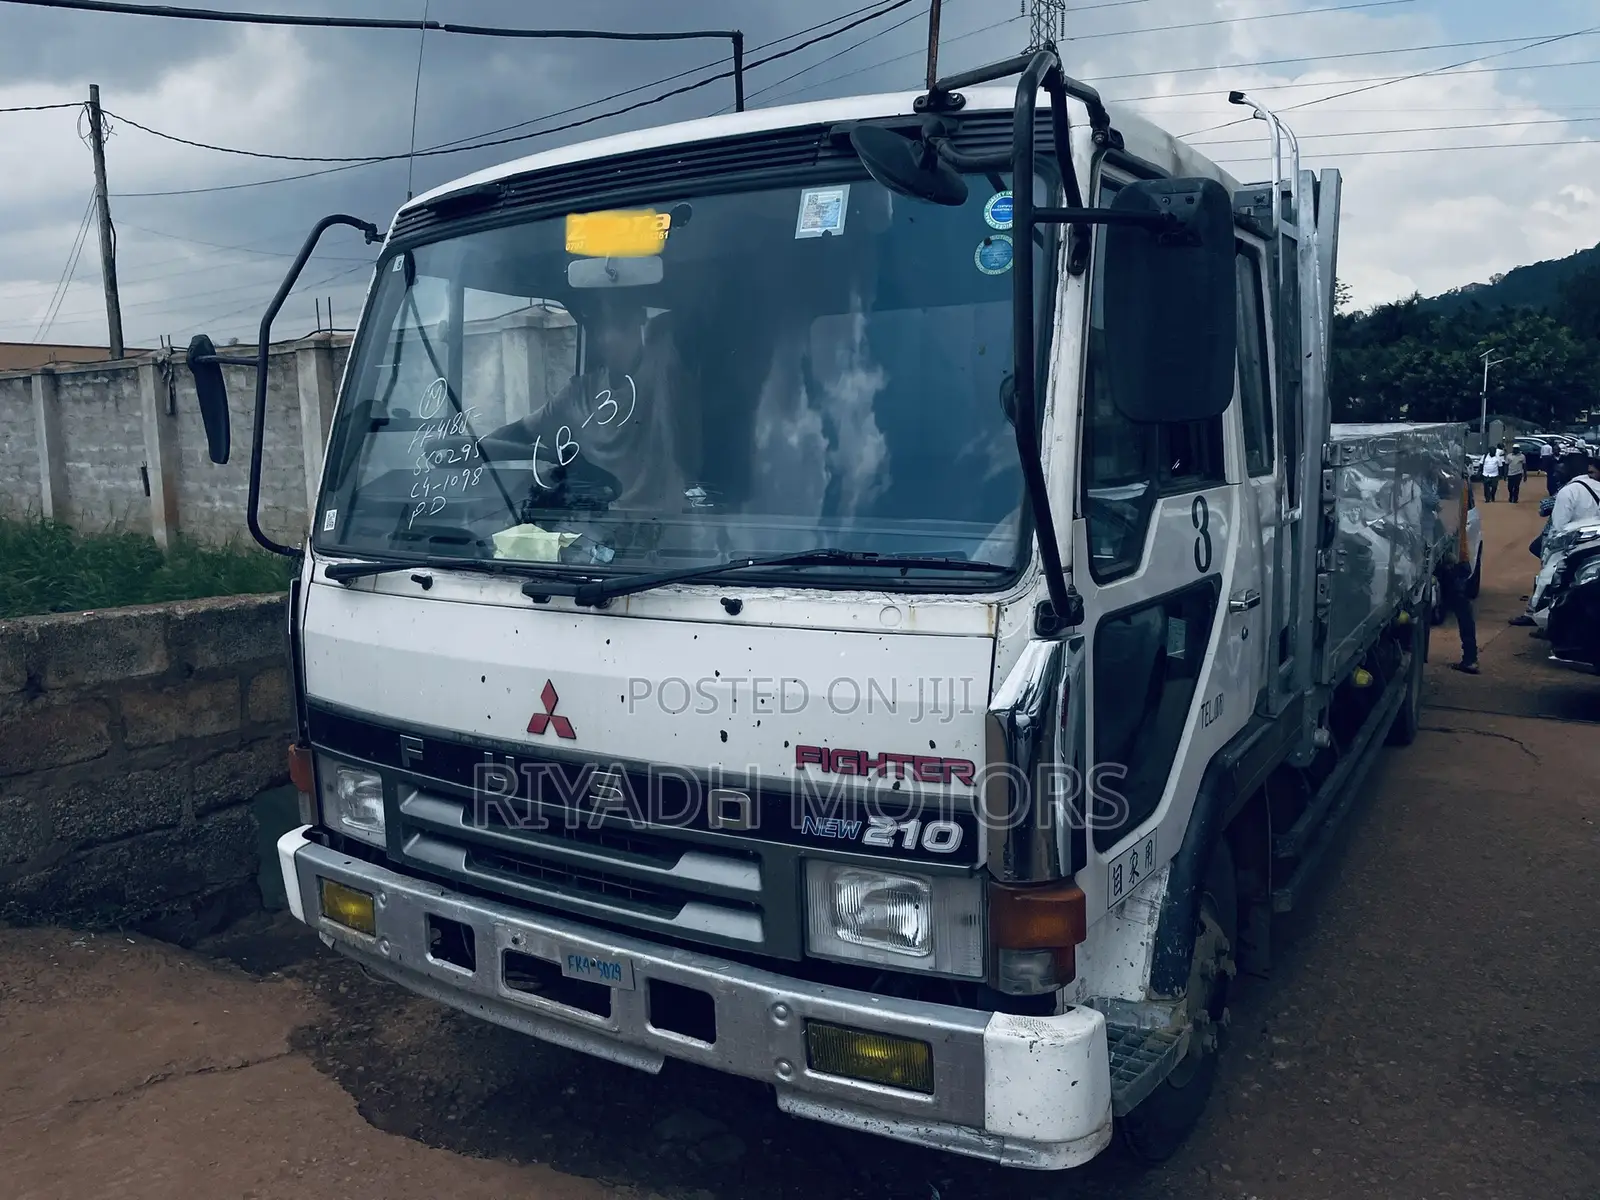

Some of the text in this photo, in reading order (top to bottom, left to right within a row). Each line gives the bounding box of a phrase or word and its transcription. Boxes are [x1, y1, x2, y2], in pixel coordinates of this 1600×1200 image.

[400, 734, 751, 828] FUSO
[795, 745, 977, 787] FIGHTER
[801, 815, 963, 853] NEW 210
[1112, 839, 1155, 896] 自家用
